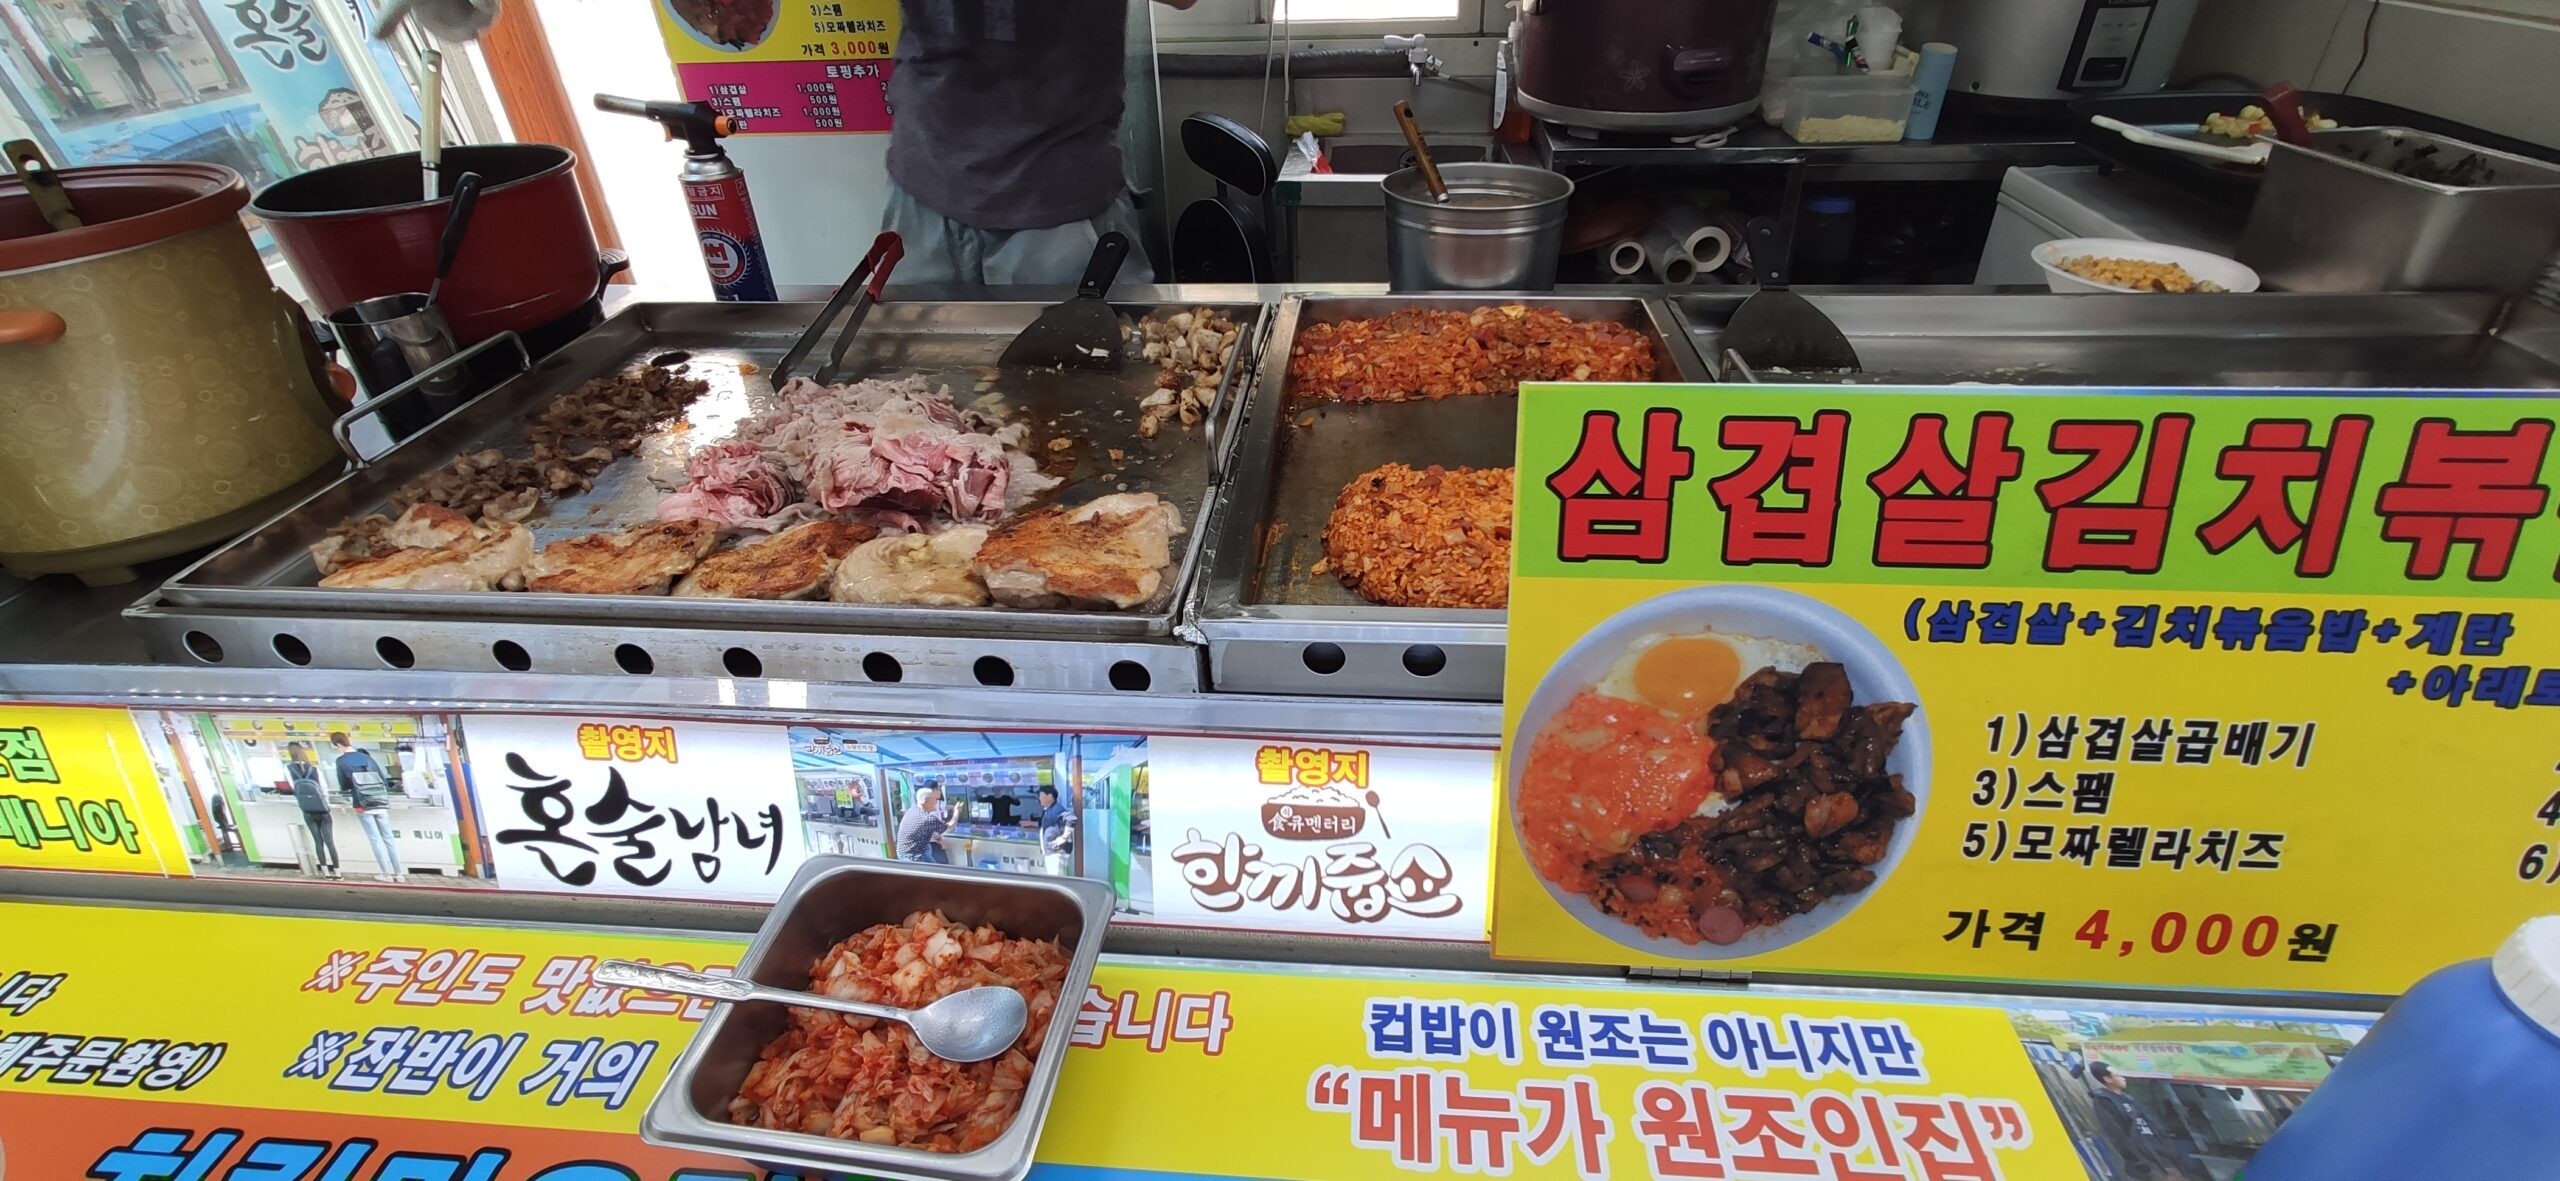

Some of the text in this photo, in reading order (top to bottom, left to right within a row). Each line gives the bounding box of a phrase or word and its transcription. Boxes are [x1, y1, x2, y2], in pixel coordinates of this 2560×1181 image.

[801, 40, 890, 56] 가격 3,000원
[826, 64, 880, 79] 토핑추가
[796, 82, 836, 94] 1,000원
[809, 95, 838, 105] 500원
[802, 106, 842, 118] 1,000원
[815, 118, 844, 128] 500원
[1546, 408, 2560, 582] 삼겹살김치볶
[577, 724, 679, 765] 촬영지
[1255, 745, 1371, 789] 촬영지
[1943, 908, 2340, 963] 가격 4,000원
[1368, 1001, 1922, 1077] 컵밥이 원조는 아니지만
[517, 1037, 661, 1111] 거의
